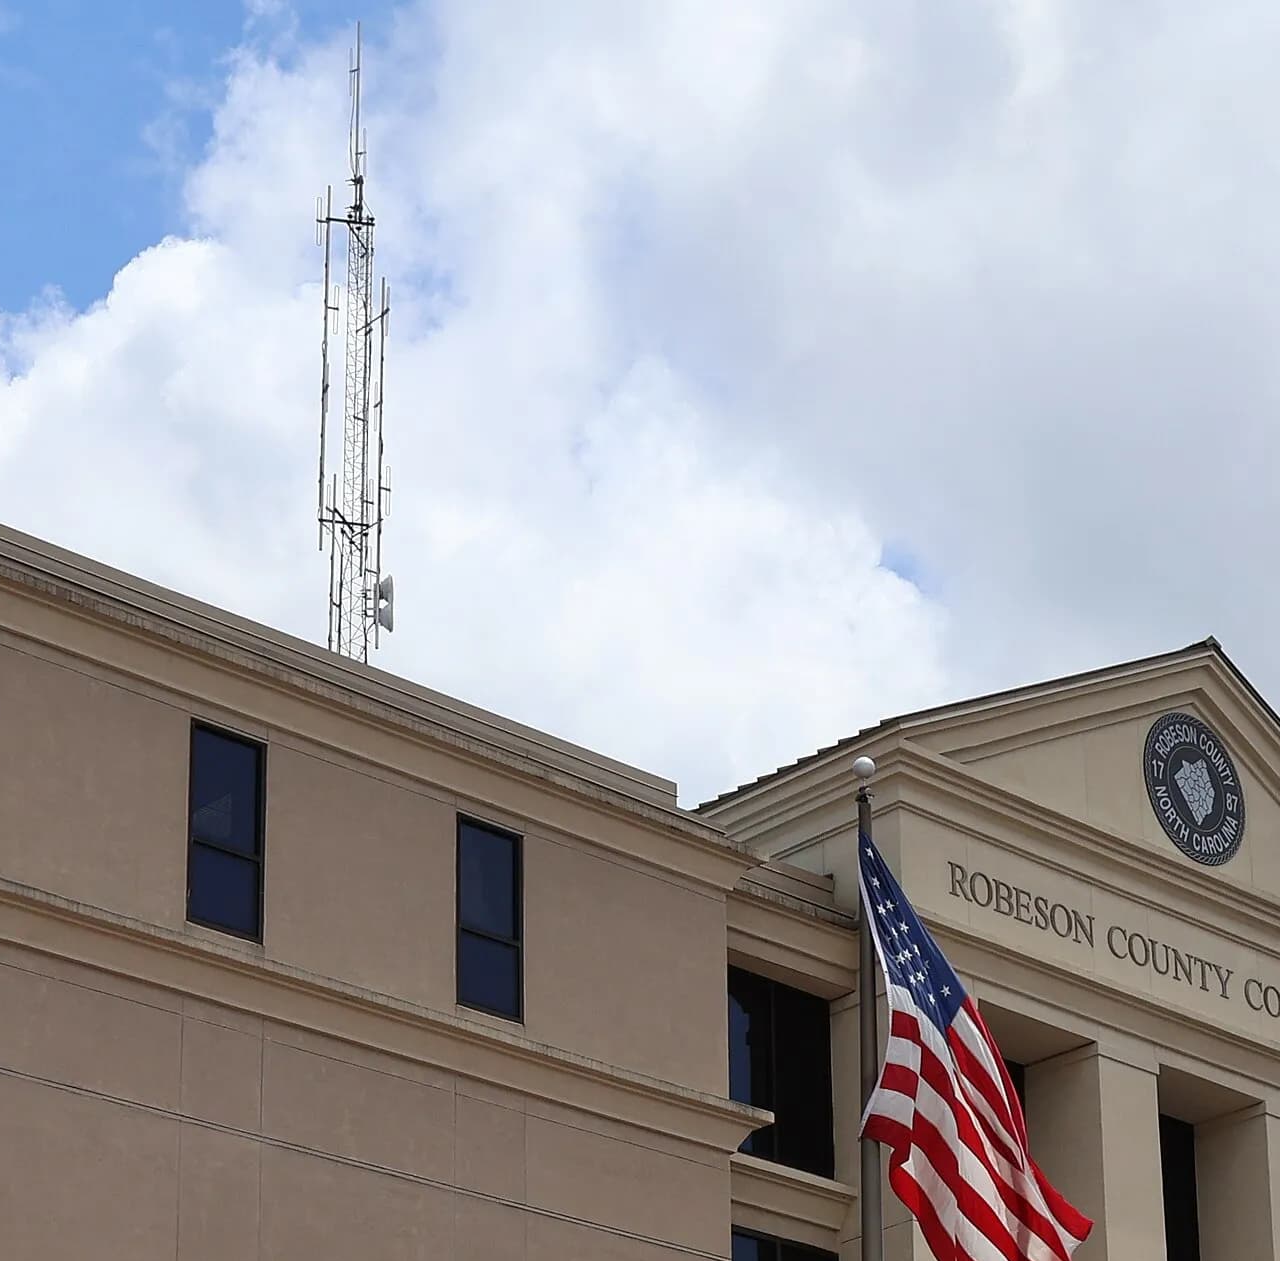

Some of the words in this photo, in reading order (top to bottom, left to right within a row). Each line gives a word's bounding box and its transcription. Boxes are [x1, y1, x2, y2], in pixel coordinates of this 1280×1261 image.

[1152, 758, 1165, 780] 17
[1154, 723, 1198, 759] ROBESON
[1199, 733, 1235, 787] COUNTY
[1154, 785, 1190, 843] NORTH
[1192, 815, 1239, 856] CAROLINA
[1226, 793, 1239, 813] 87
[947, 860, 1096, 949] ROBESON
[1106, 925, 1234, 1000] COUNTY
